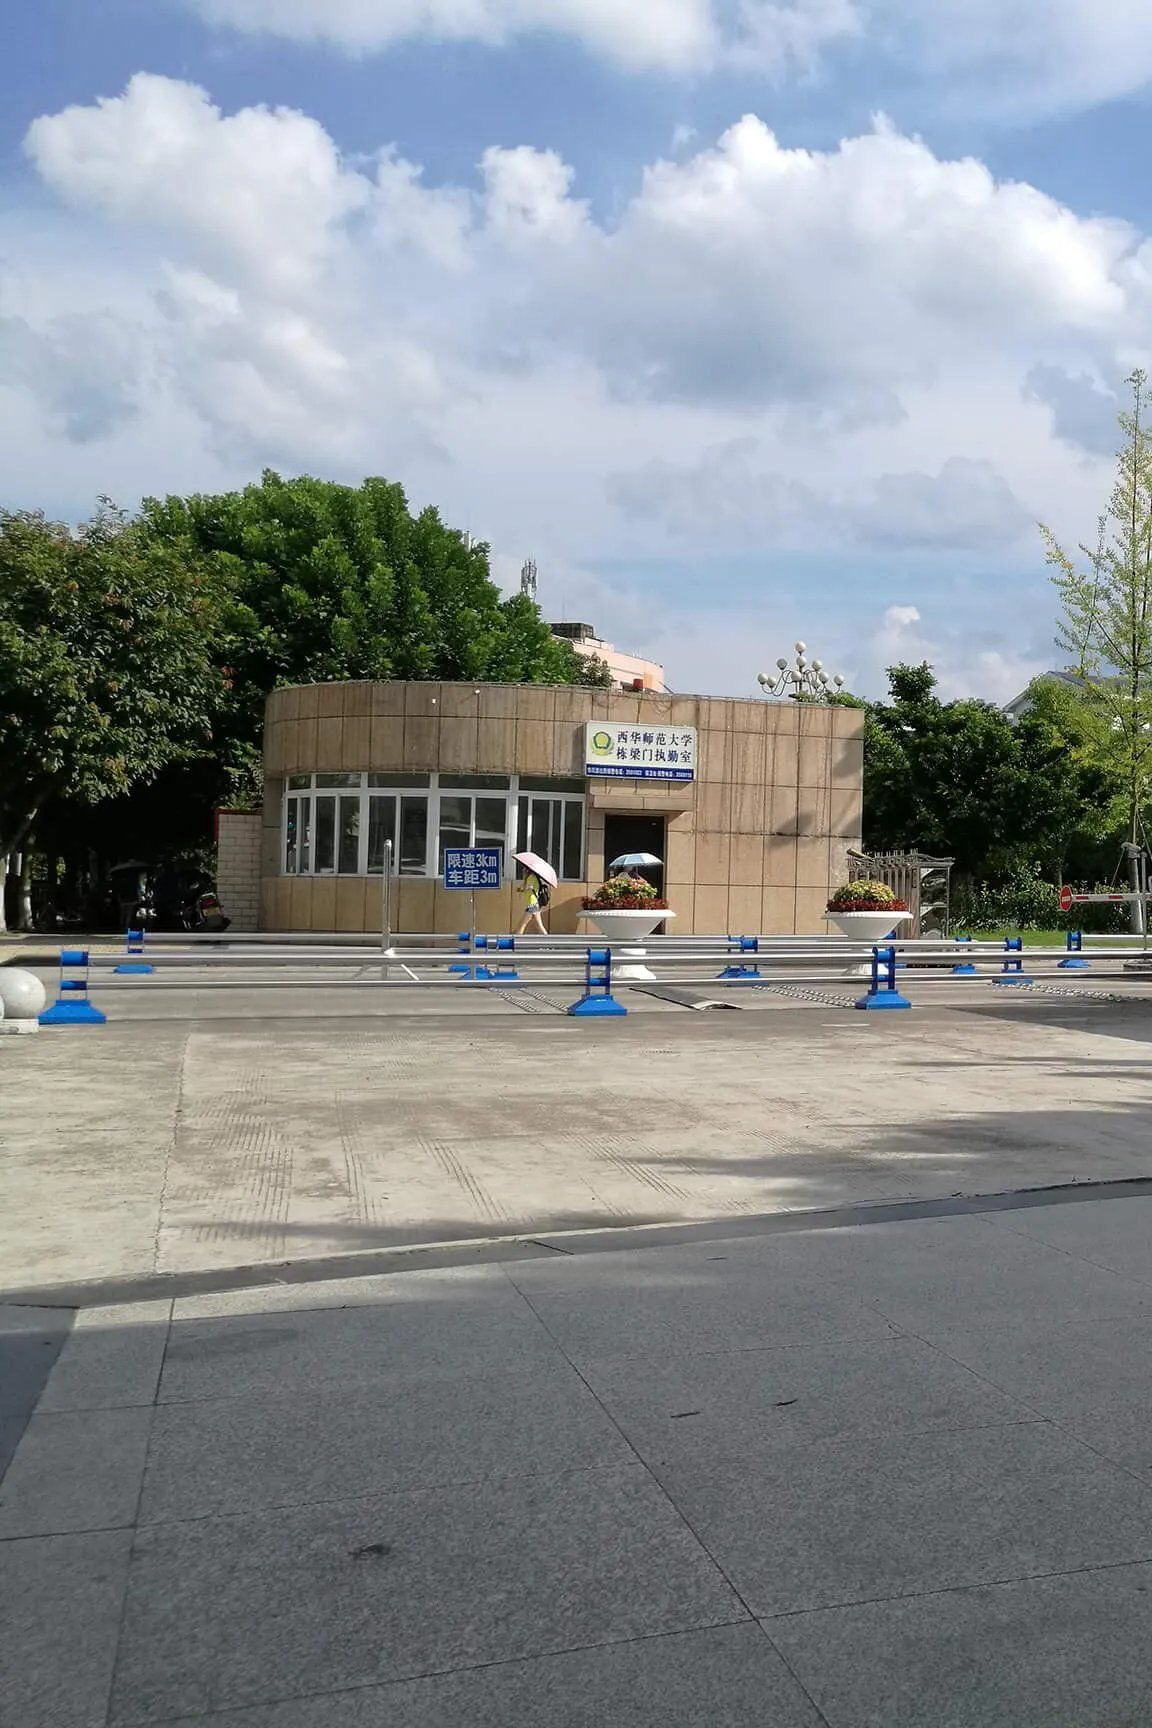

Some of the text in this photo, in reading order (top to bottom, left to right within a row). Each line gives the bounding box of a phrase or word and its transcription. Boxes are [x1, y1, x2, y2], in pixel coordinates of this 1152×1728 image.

[617, 730, 692, 747] 西华师范大学
[616, 746, 692, 763] 栋梁门执勤室
[447, 853, 497, 868] 限速3km
[447, 869, 497, 885] 车距3m
